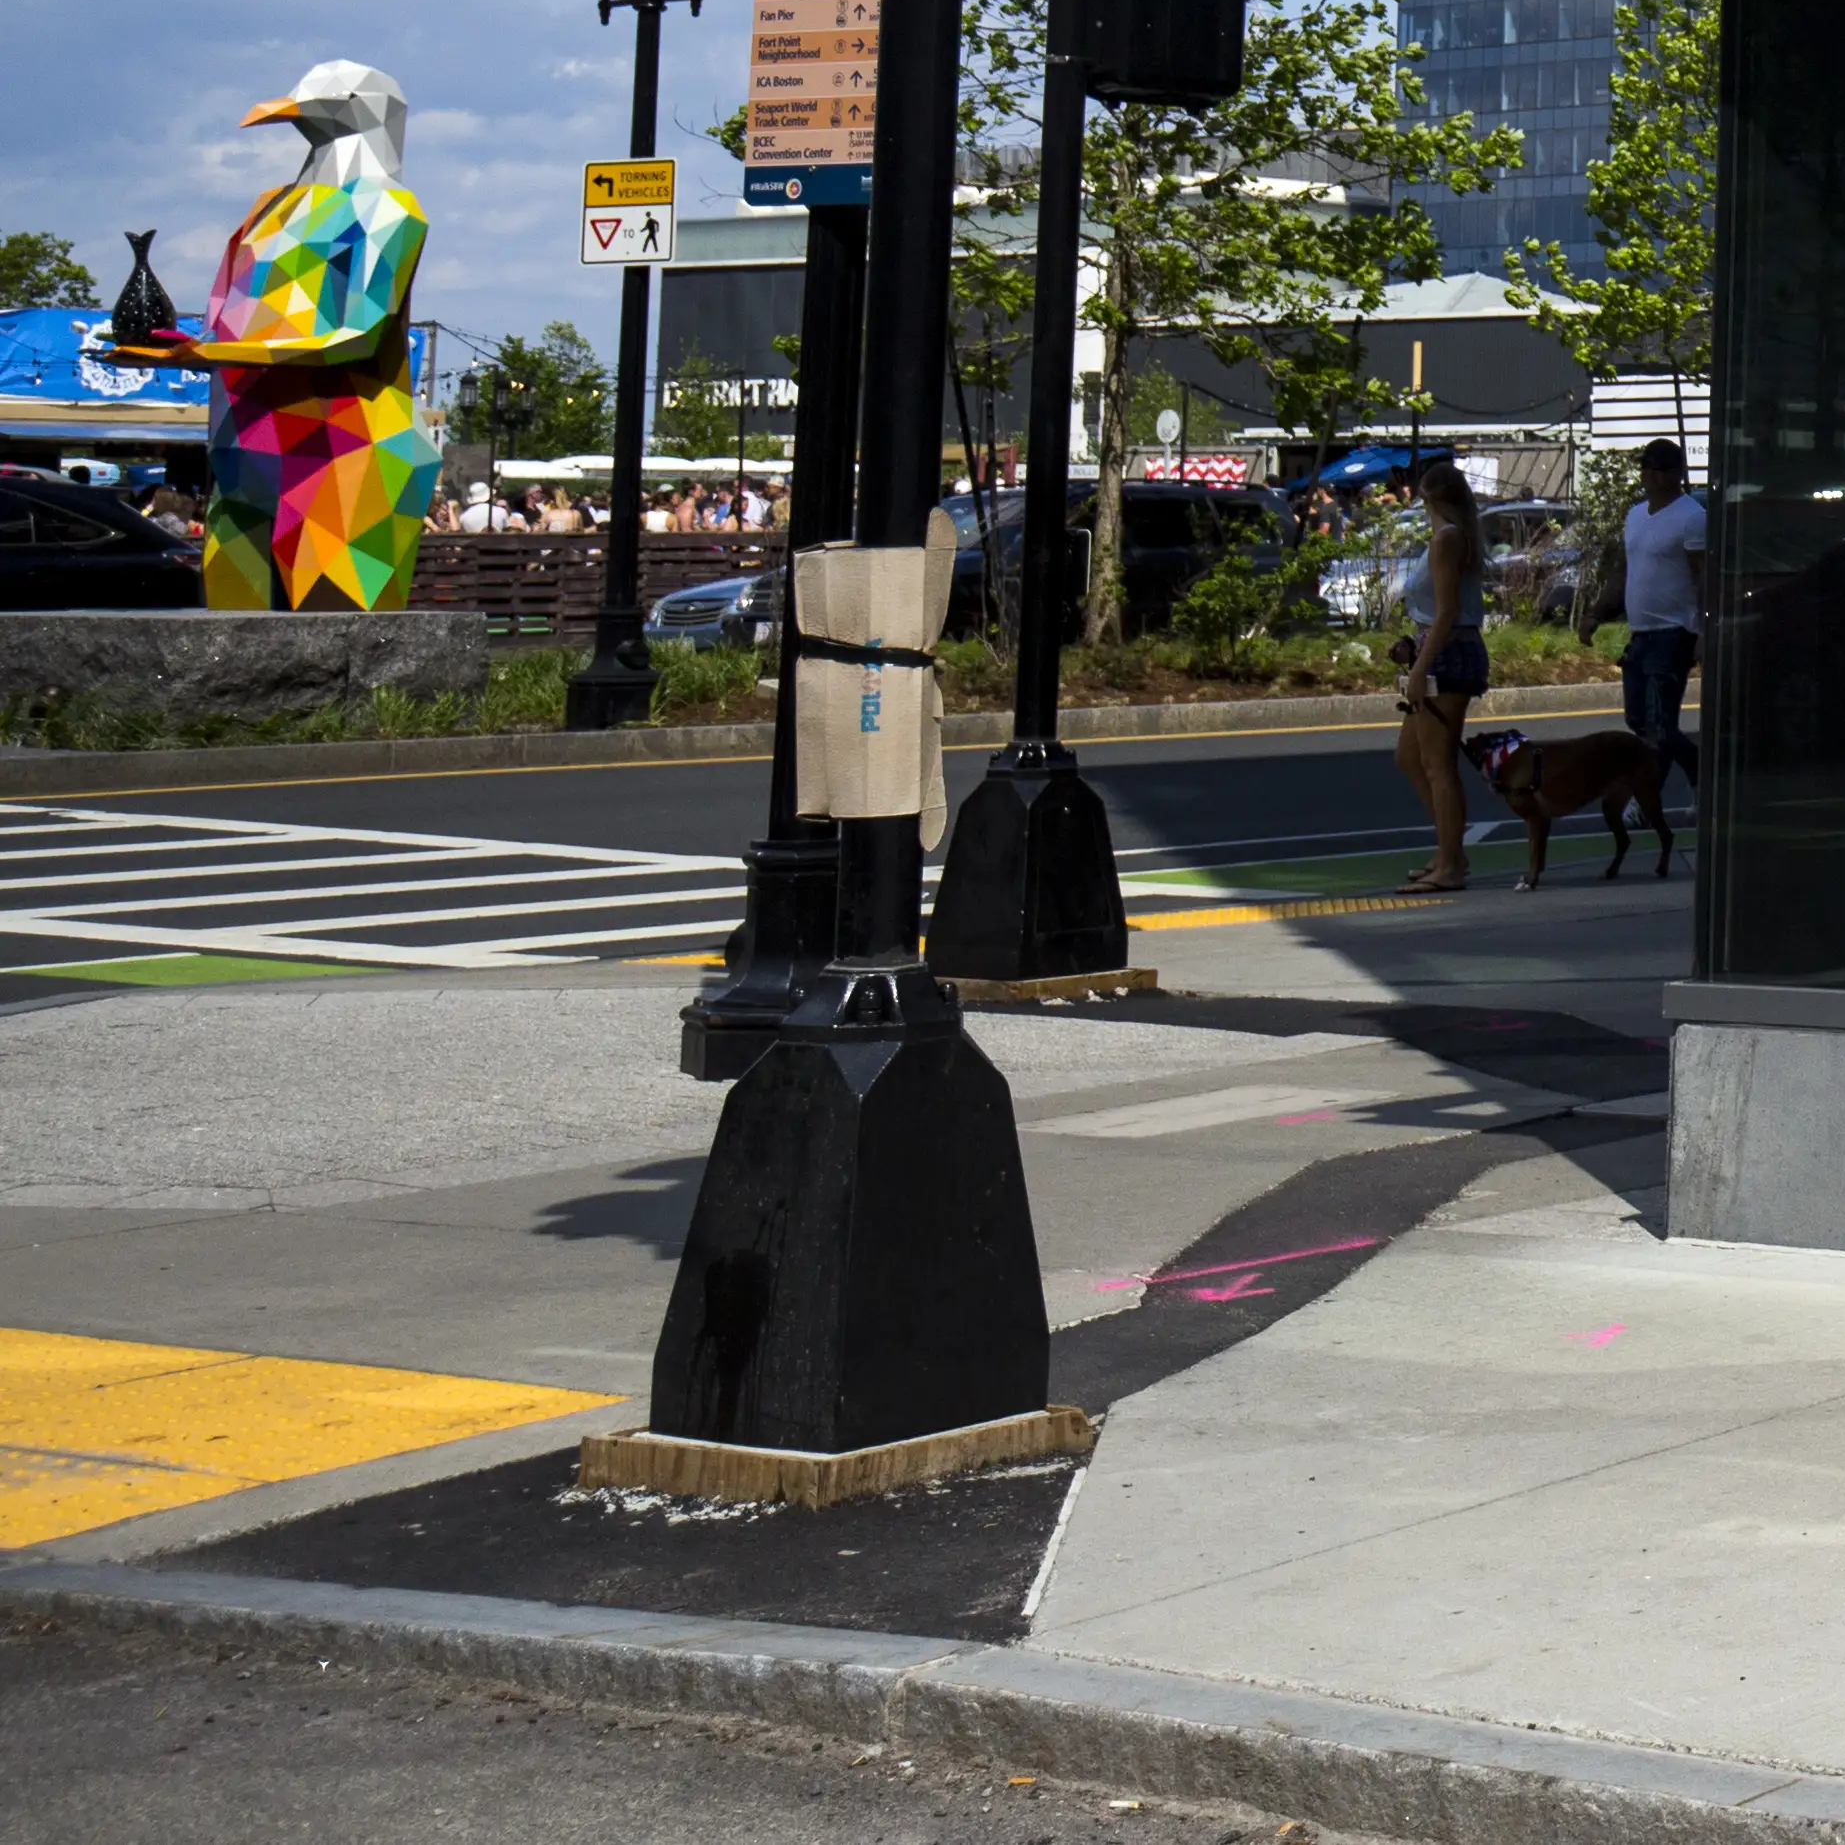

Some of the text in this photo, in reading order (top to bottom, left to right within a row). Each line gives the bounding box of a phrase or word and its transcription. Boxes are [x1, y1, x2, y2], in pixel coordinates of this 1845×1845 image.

[760, 9, 795, 22] Fan Pier
[759, 36, 802, 48] Fort Point
[758, 47, 821, 63] Neighborhood
[756, 76, 804, 88] ICA Boston
[755, 100, 818, 116] Seaport World
[755, 115, 811, 128] Trade Center
[753, 136, 776, 148] BCEC
[752, 147, 833, 160] Convention Center
[617, 185, 670, 199] VEHICLES
[623, 229, 635, 239] TO
